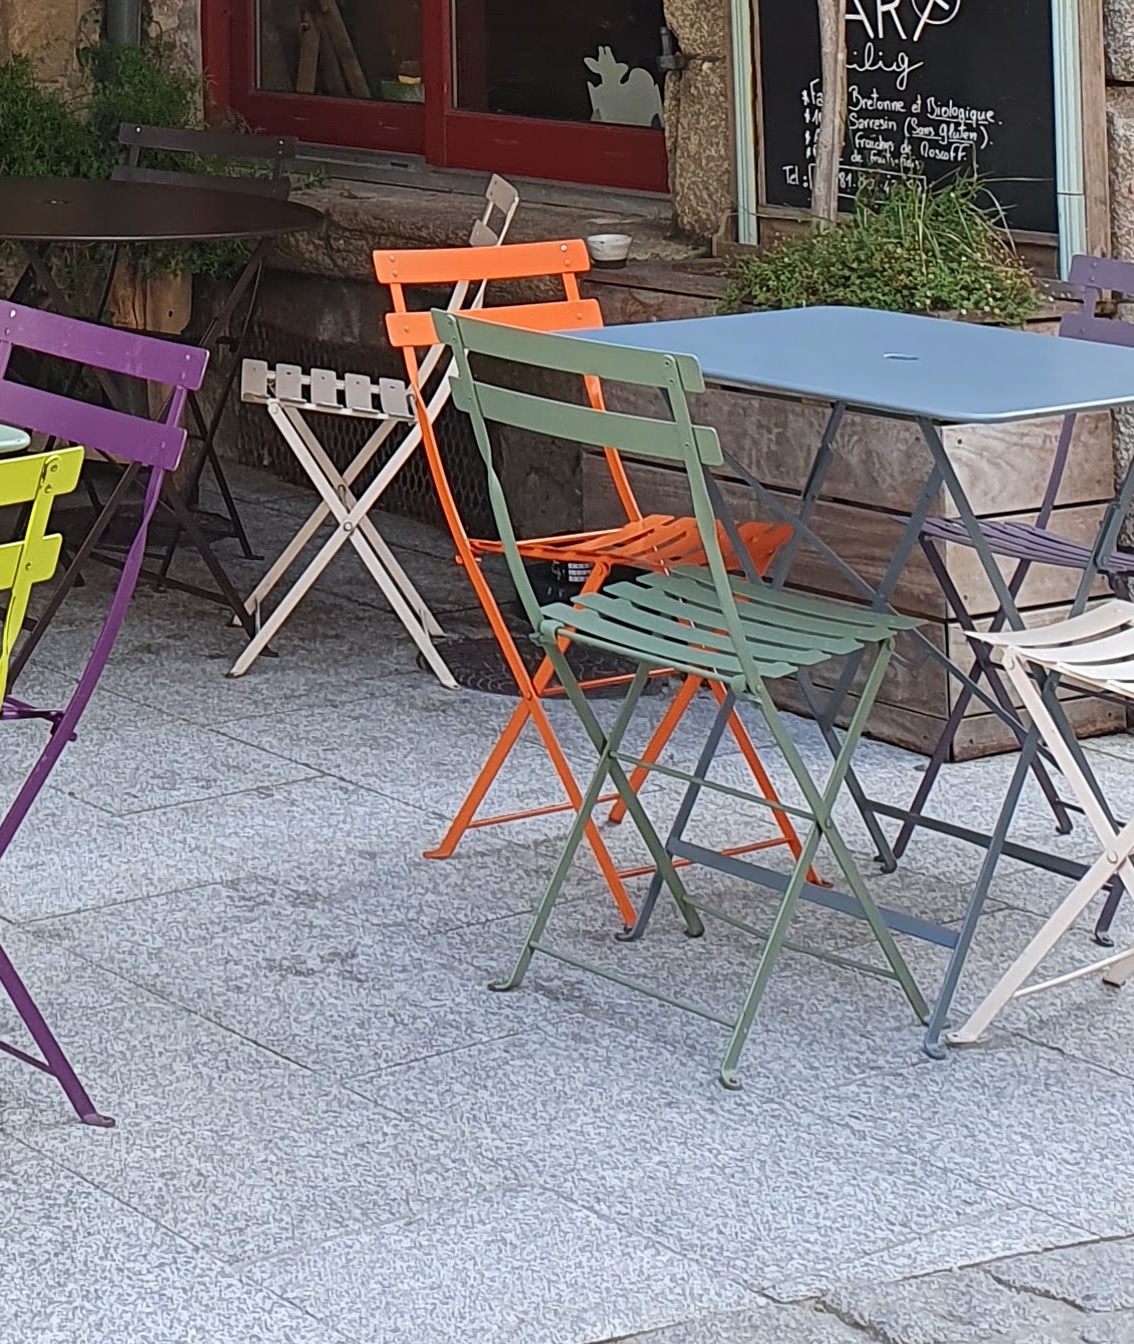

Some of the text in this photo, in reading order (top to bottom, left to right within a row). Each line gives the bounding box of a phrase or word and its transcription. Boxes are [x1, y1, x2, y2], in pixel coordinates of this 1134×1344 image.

[844, 41, 925, 91] ilig
[848, 85, 907, 112] Bretonne
[911, 94, 922, 114] et
[850, 149, 863, 163] de
